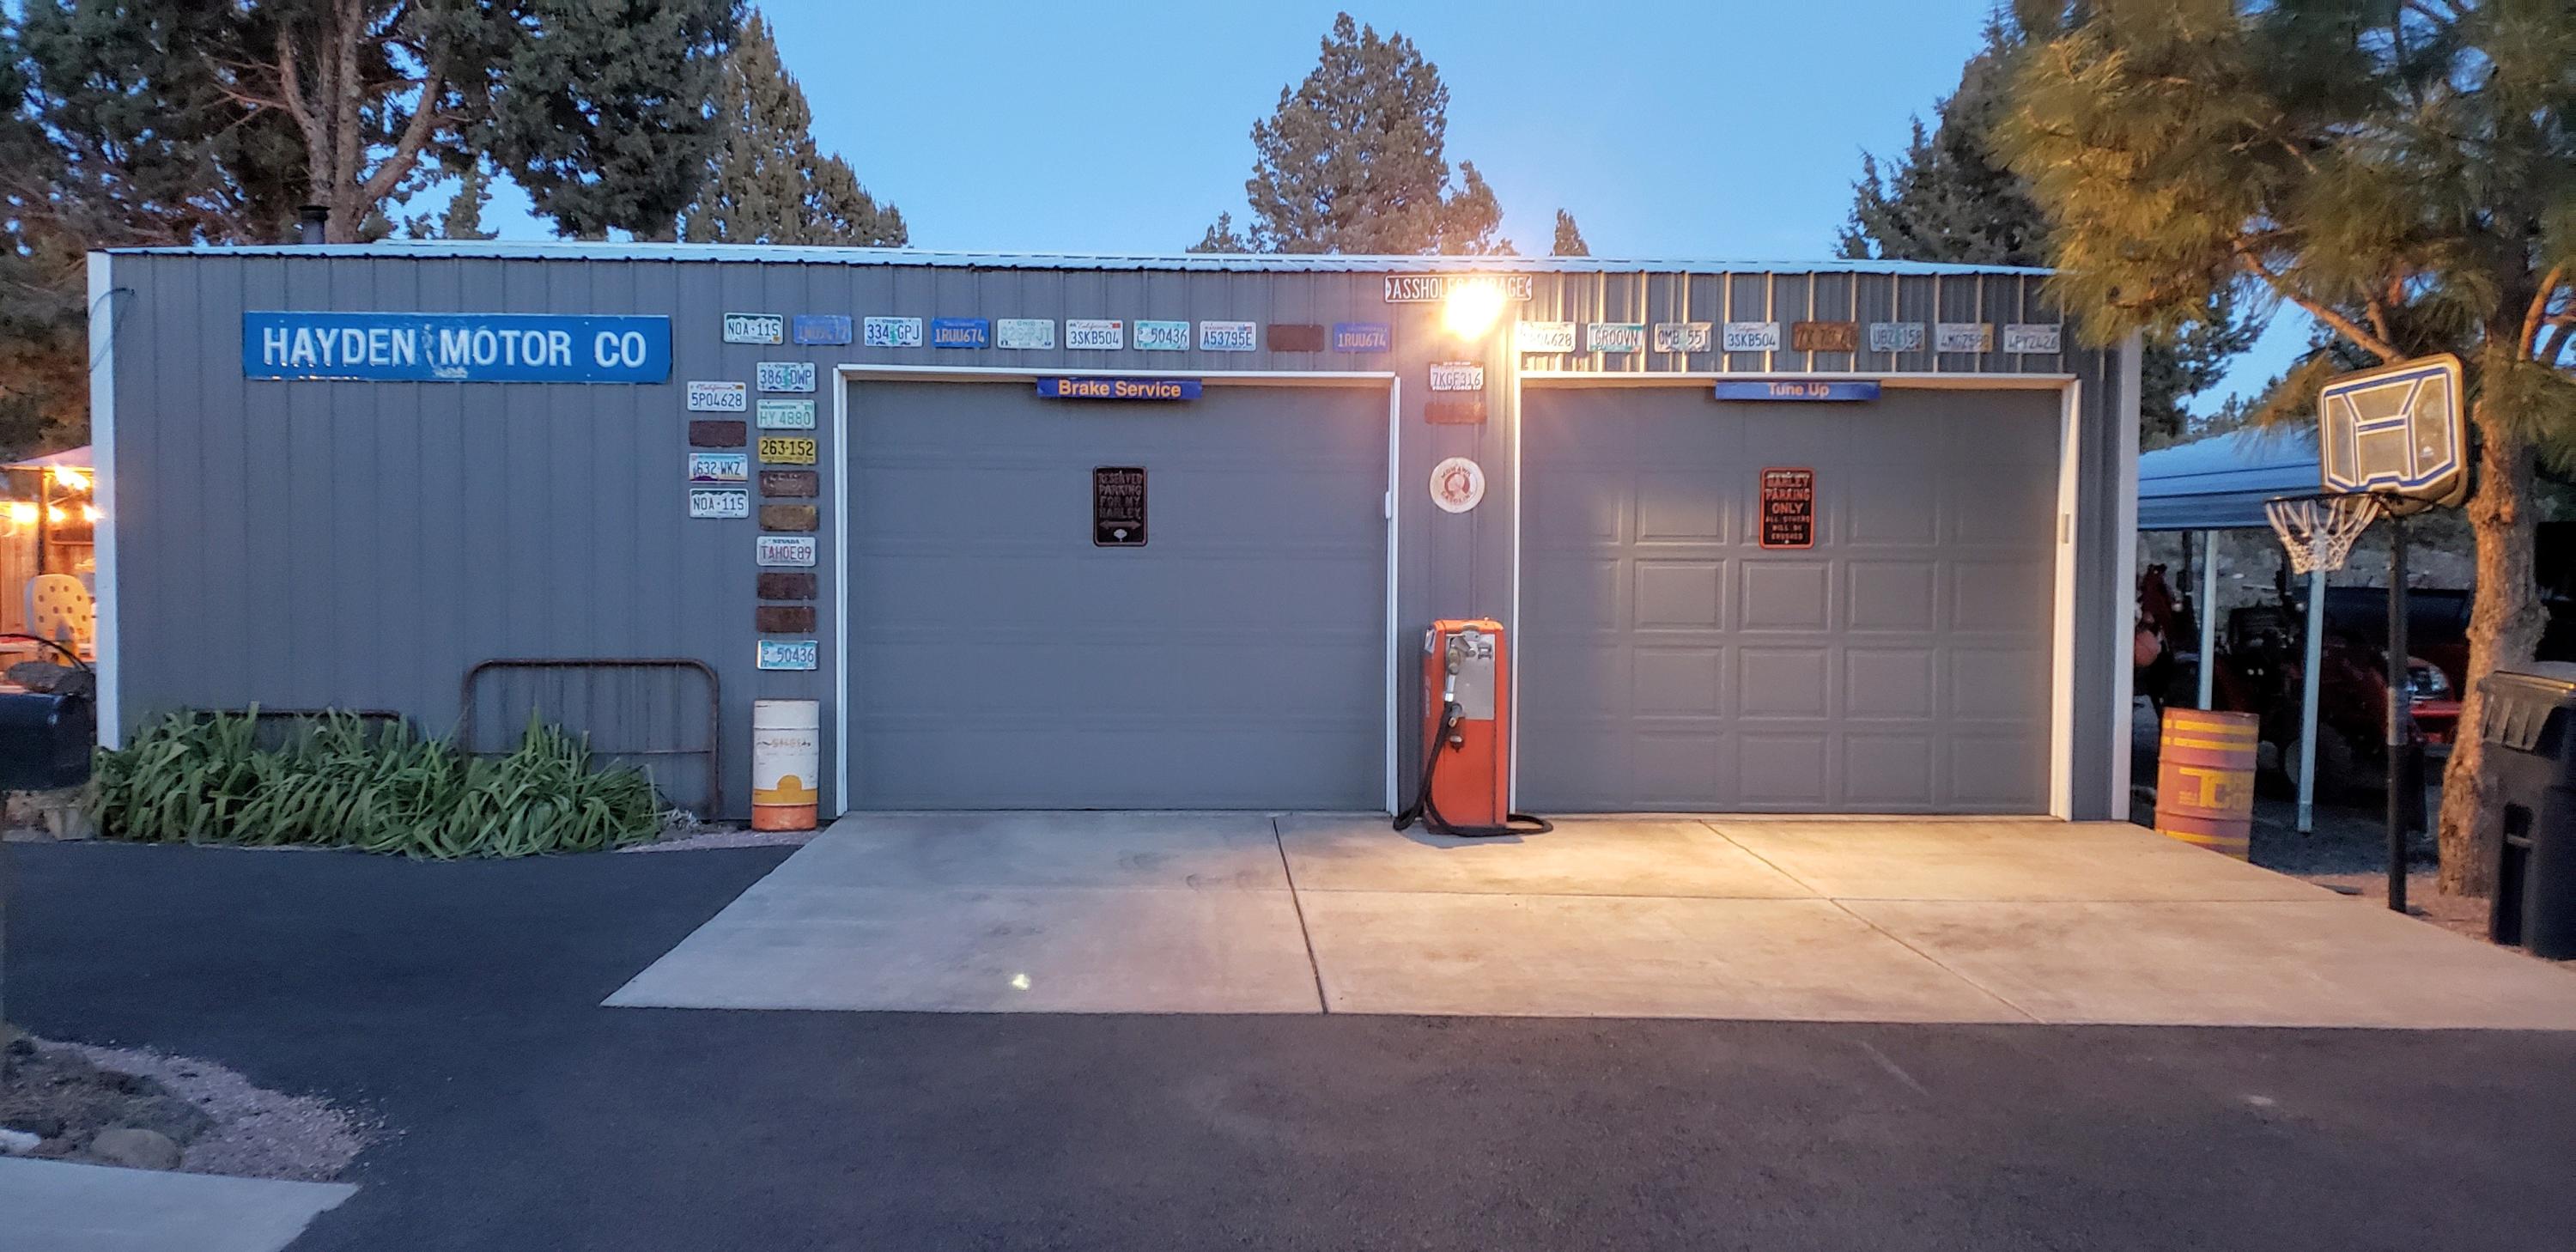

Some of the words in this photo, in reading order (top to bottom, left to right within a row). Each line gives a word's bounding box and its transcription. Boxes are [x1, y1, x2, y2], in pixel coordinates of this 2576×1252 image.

[867, 324, 889, 340] 334
[897, 325, 920, 340] GPJ
[1070, 331, 1119, 344] 3SKB504
[1151, 327, 1188, 344] 50436
[1204, 330, 1253, 346] A53795E
[1728, 333, 1776, 346] 3SKB504
[263, 327, 416, 367] HAYDEN
[440, 329, 572, 368] MOTOR
[593, 331, 647, 368] CO
[760, 369, 782, 385] 386
[1432, 371, 1480, 386] 7KGF316
[1058, 379, 1110, 396] Brake
[1115, 380, 1182, 397] Service
[1768, 382, 1803, 397] Tune
[1807, 382, 1830, 398] Up
[760, 411, 775, 426] HY
[779, 411, 811, 426] 4880
[1097, 472, 1143, 484] RESERVED
[1098, 484, 1142, 496] PARKING
[1765, 488, 1810, 501] PARKING
[1100, 495, 1121, 507] FOR
[1125, 495, 1141, 507] MY
[1772, 502, 1803, 514] ONLY
[1099, 507, 1141, 519] HARLEY
[761, 545, 811, 560] TAHOE89
[776, 647, 814, 663] 50436
